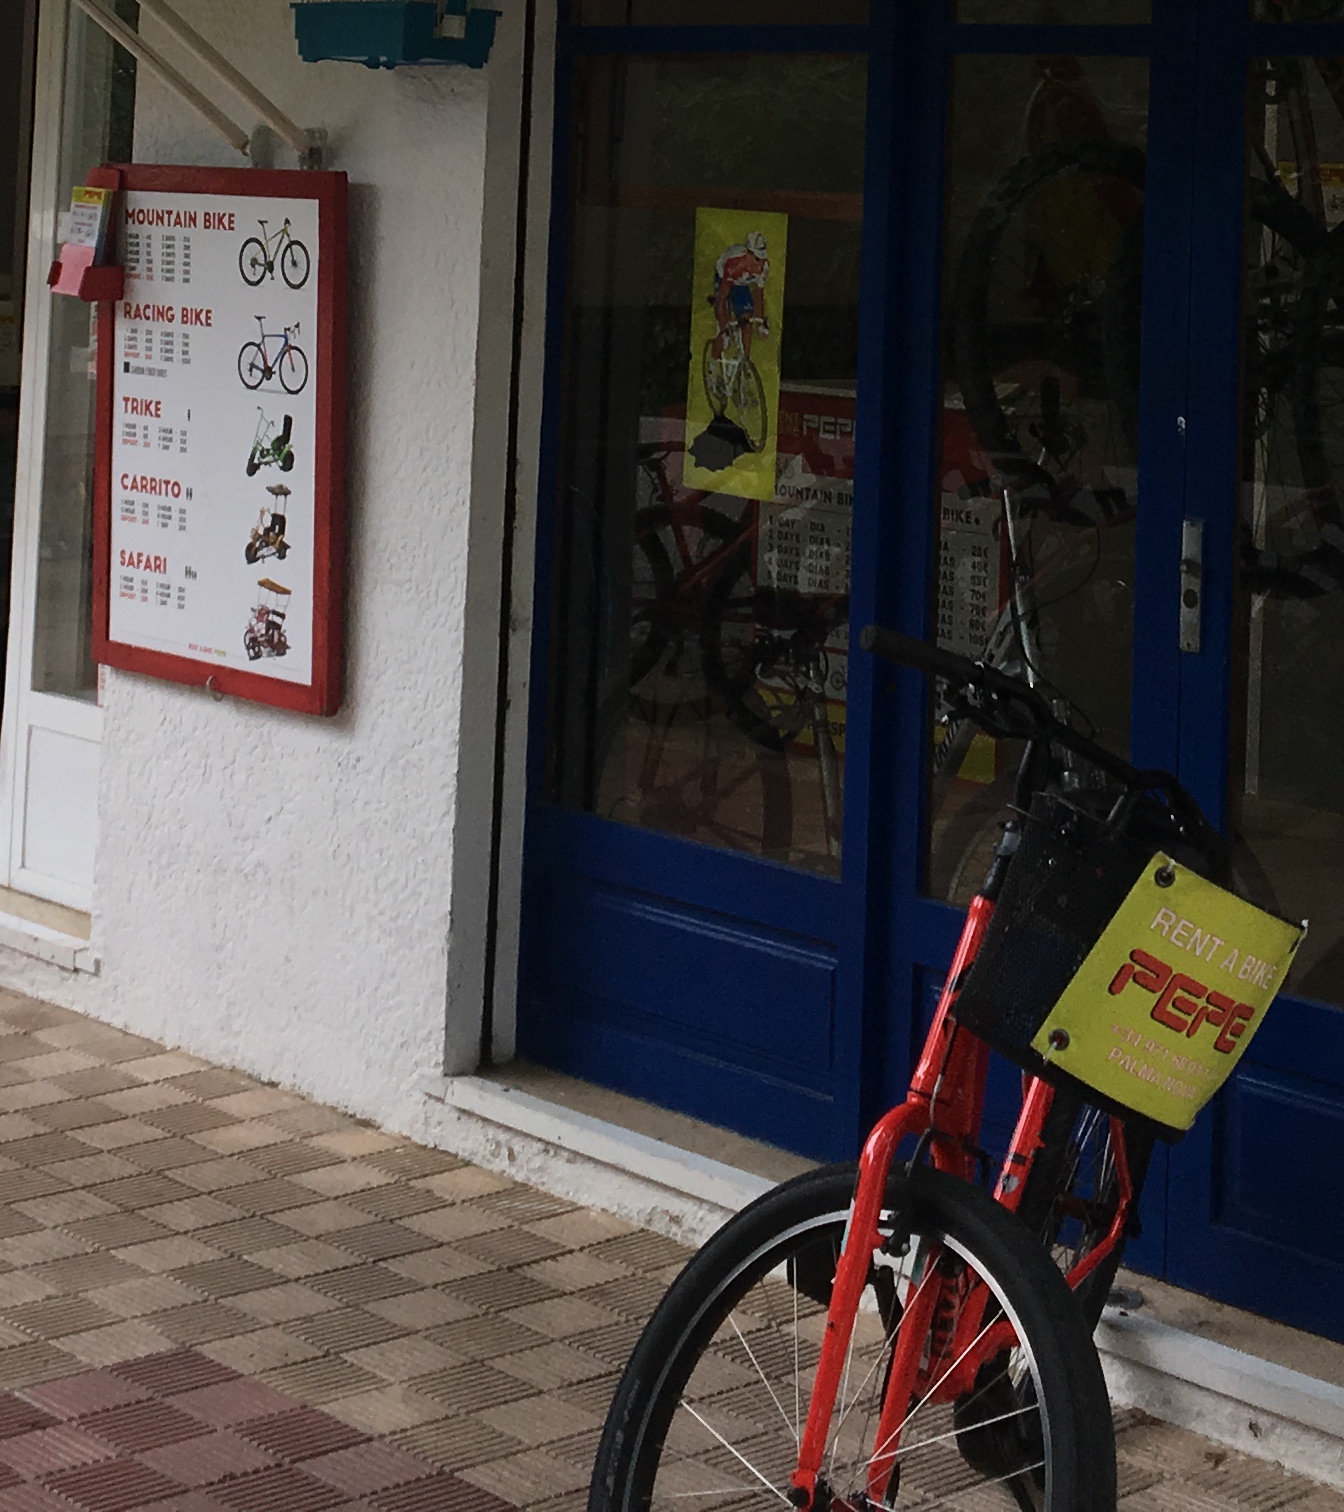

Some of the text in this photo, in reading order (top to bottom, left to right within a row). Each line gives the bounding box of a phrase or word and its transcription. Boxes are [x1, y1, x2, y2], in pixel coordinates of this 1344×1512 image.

[125, 208, 235, 231] MOUNTAIN BIKE
[123, 302, 213, 327] RACING BIKE
[122, 396, 162, 418] TRIKE
[120, 473, 181, 499] CARRITO
[119, 549, 167, 575] SAFARI
[1150, 906, 1277, 990] RENT A BIKE
[1107, 948, 1255, 1054] PEPE
